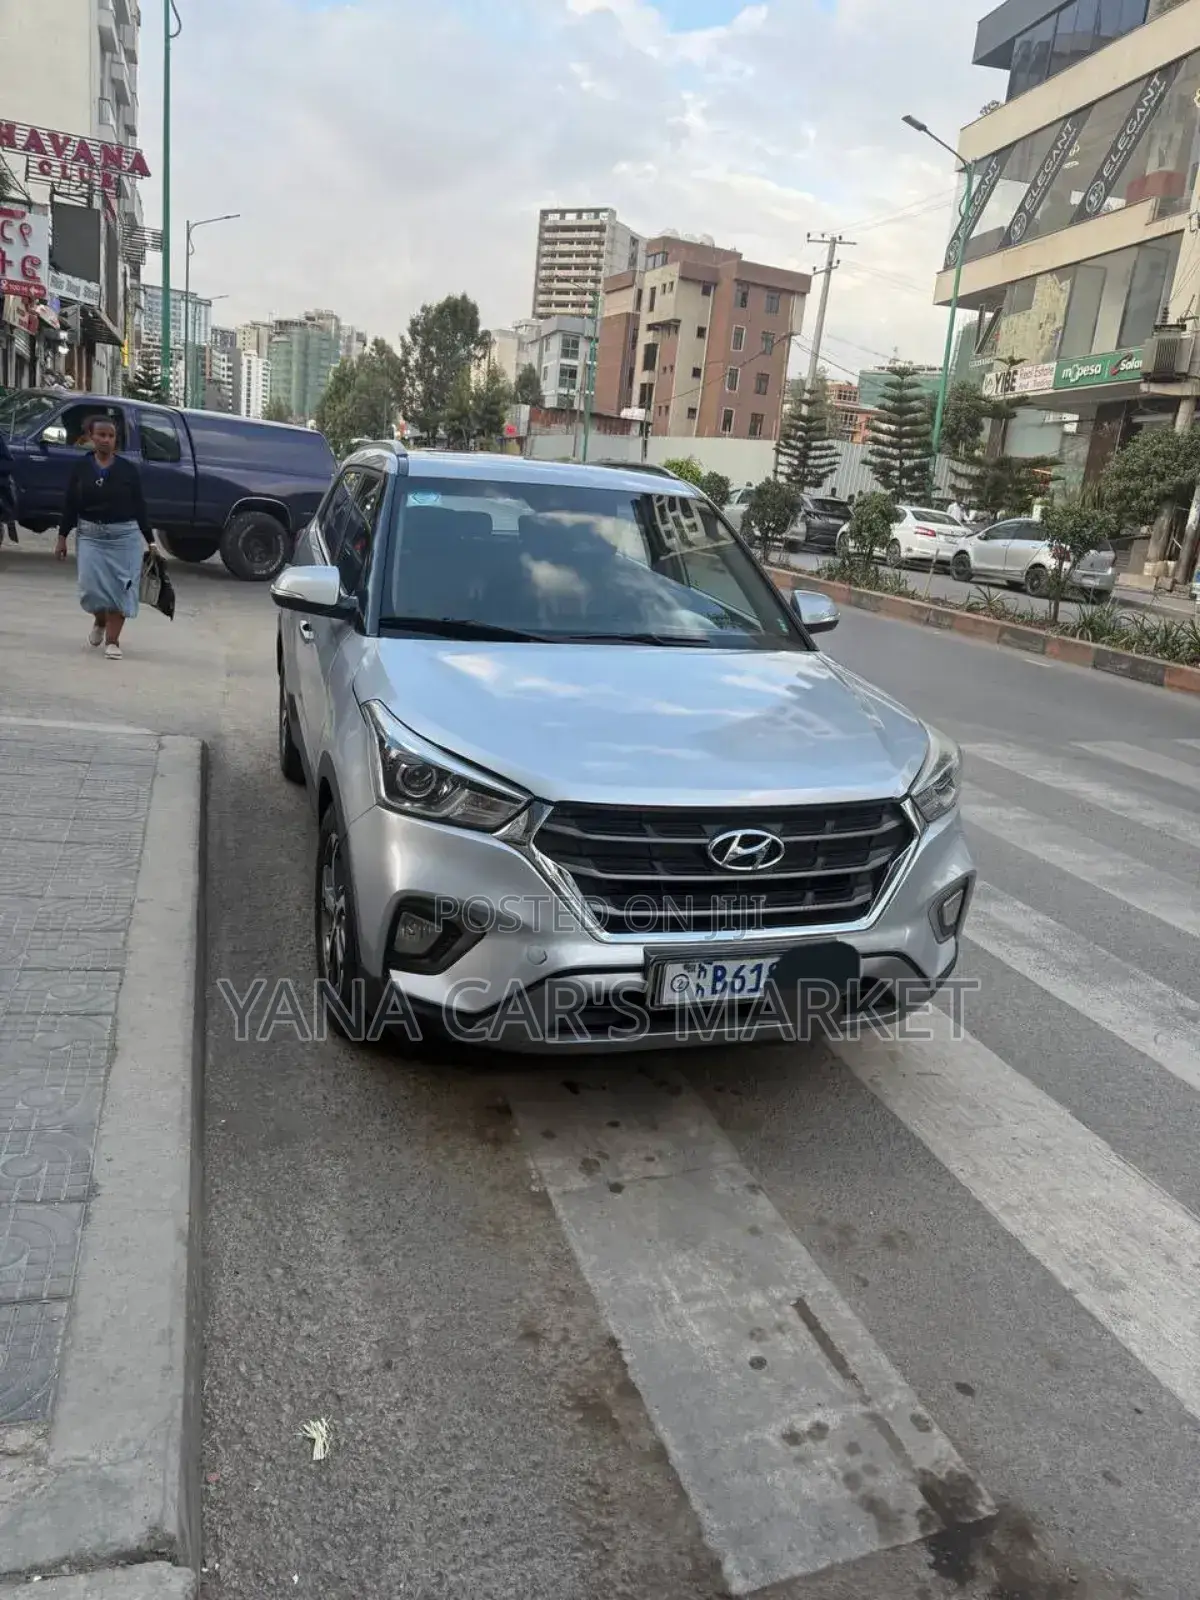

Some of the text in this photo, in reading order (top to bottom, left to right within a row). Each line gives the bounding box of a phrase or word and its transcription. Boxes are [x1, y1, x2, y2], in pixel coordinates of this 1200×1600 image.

[0, 121, 151, 177] HAVANA
[1024, 117, 1072, 210] ELEGANT
[1103, 71, 1161, 178] ELEGANT
